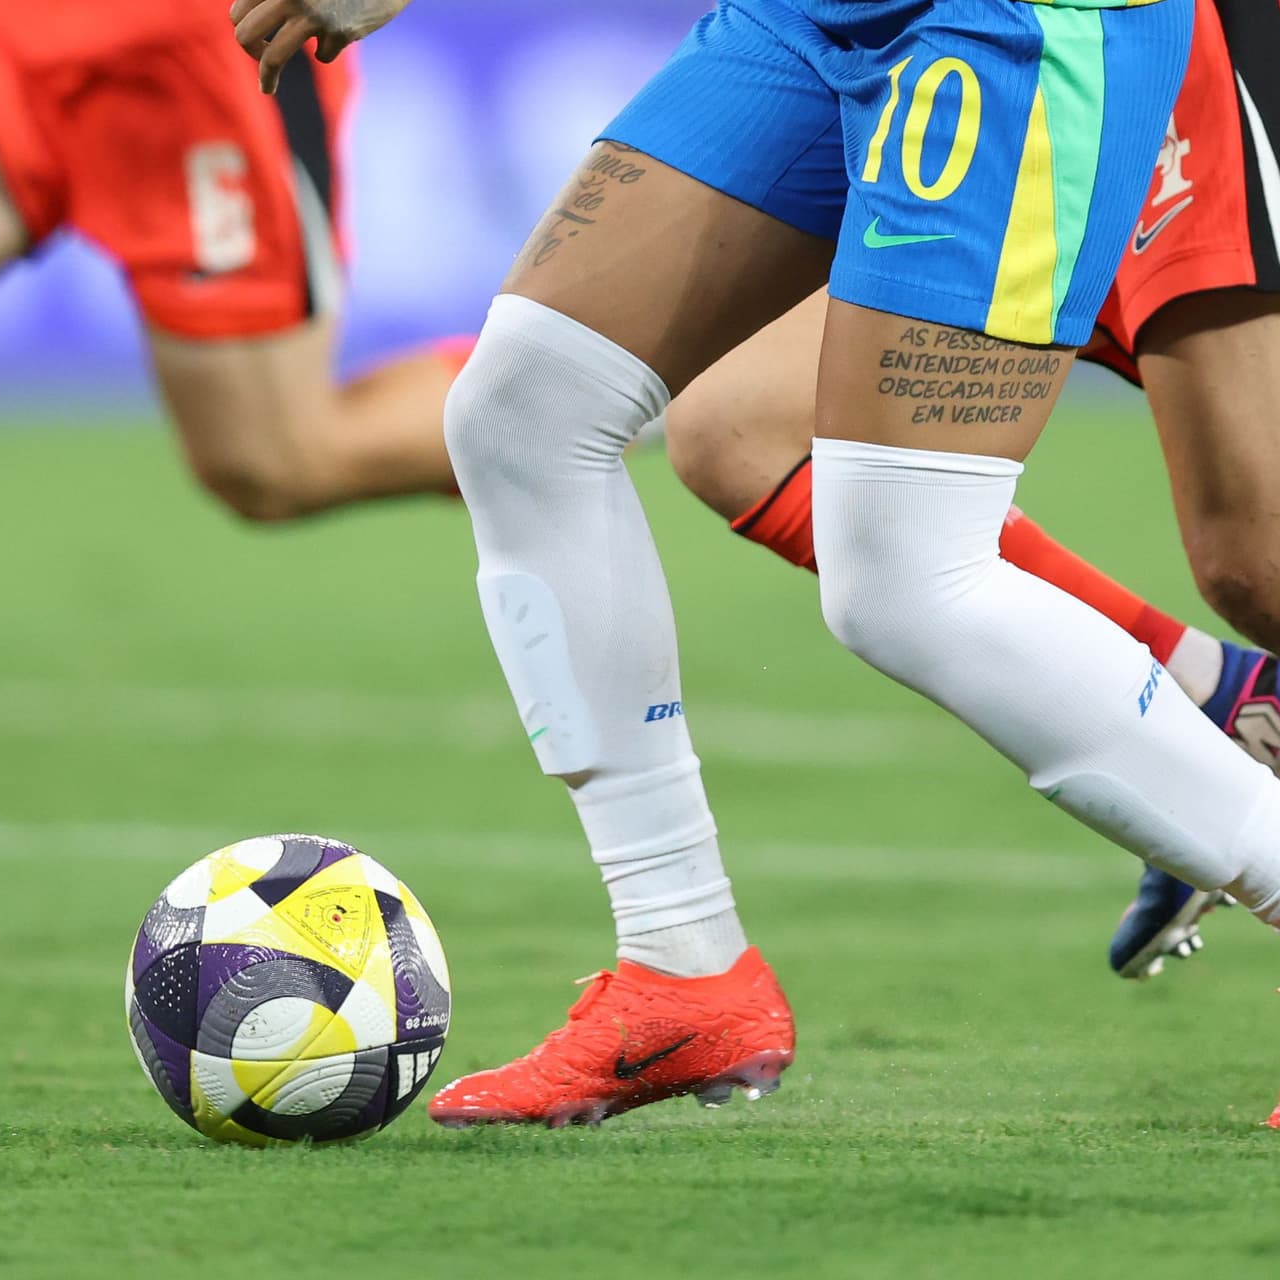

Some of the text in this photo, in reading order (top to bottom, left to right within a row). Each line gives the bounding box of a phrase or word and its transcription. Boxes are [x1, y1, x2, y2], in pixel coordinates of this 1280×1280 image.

[860, 55, 983, 202] 10
[183, 138, 258, 273] 6
[899, 327, 929, 348] AS
[879, 349, 999, 377] ENTENDEM
[1001, 358, 1016, 376] O
[877, 377, 1052, 400] OBCECADA EU SOU
[911, 404, 1023, 425] EM VENCER
